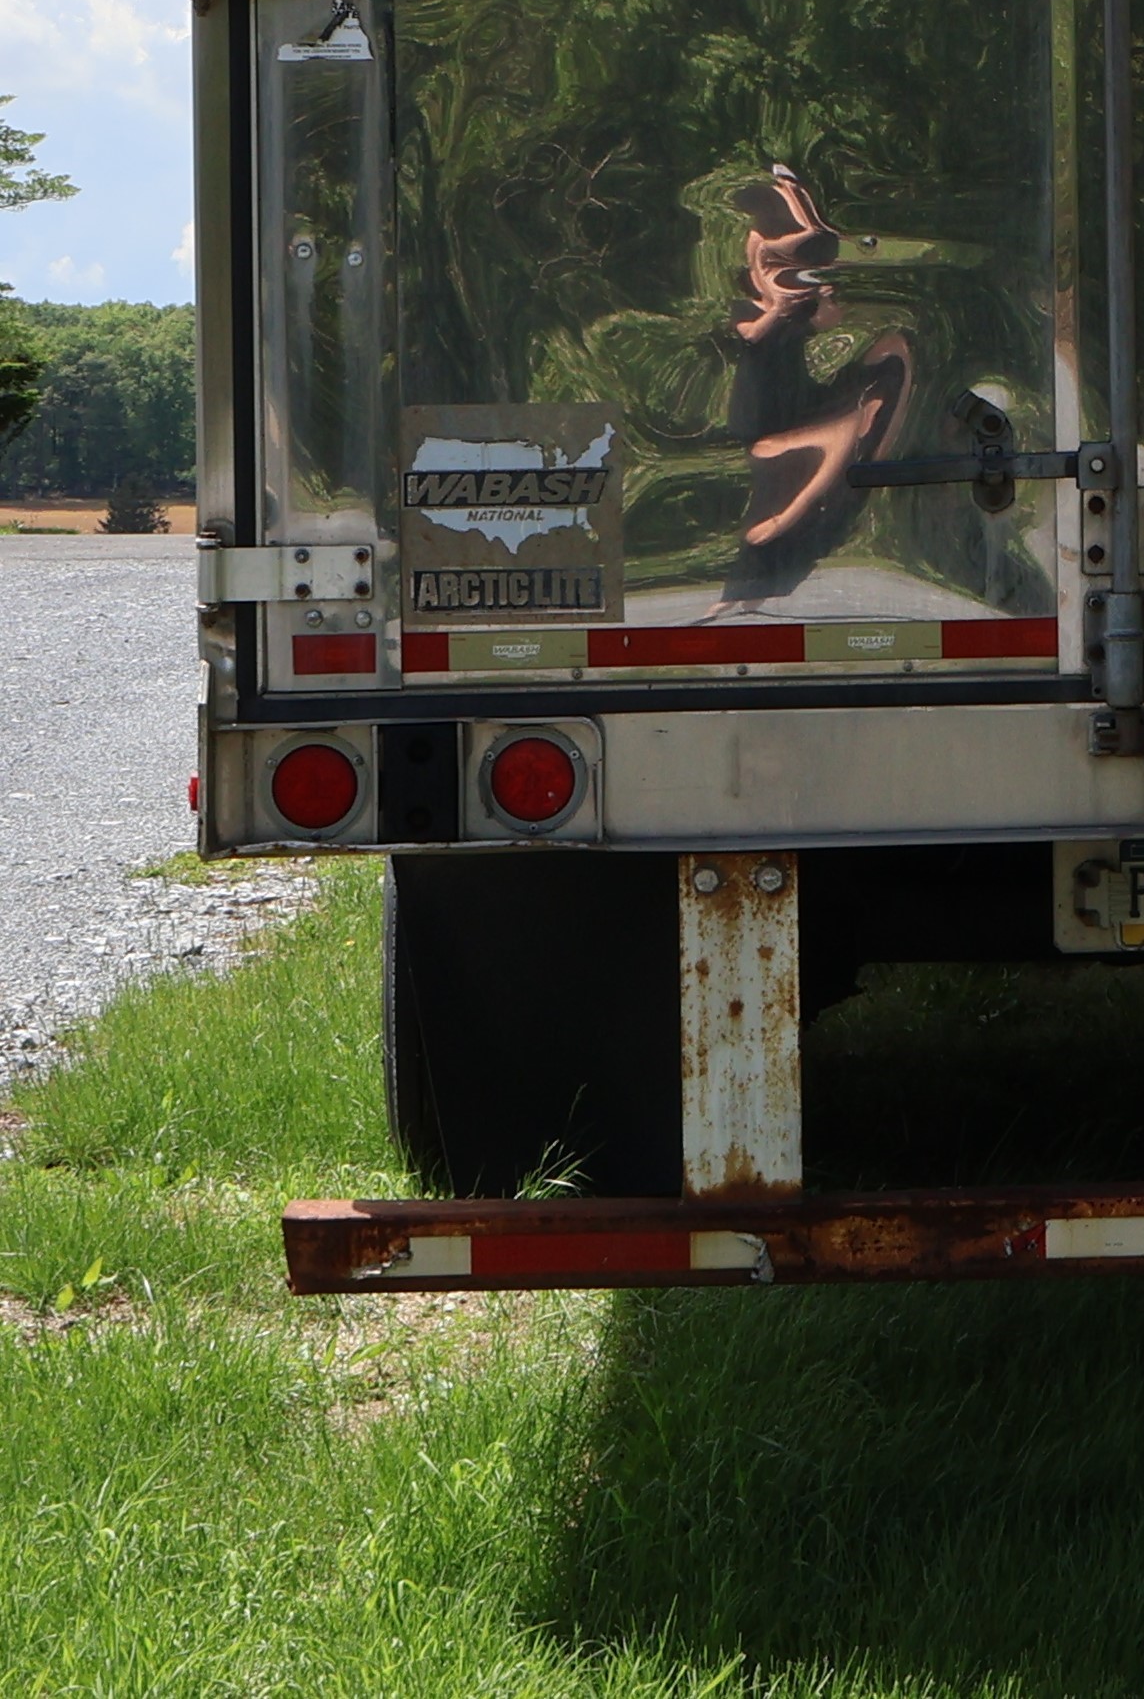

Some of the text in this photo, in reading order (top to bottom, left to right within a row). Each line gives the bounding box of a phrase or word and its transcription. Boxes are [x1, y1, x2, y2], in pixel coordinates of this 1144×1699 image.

[407, 472, 606, 505] WABASH
[466, 509, 544, 522] NATIONAL
[847, 635, 894, 647] WABASH
[493, 644, 540, 655] WABASH
